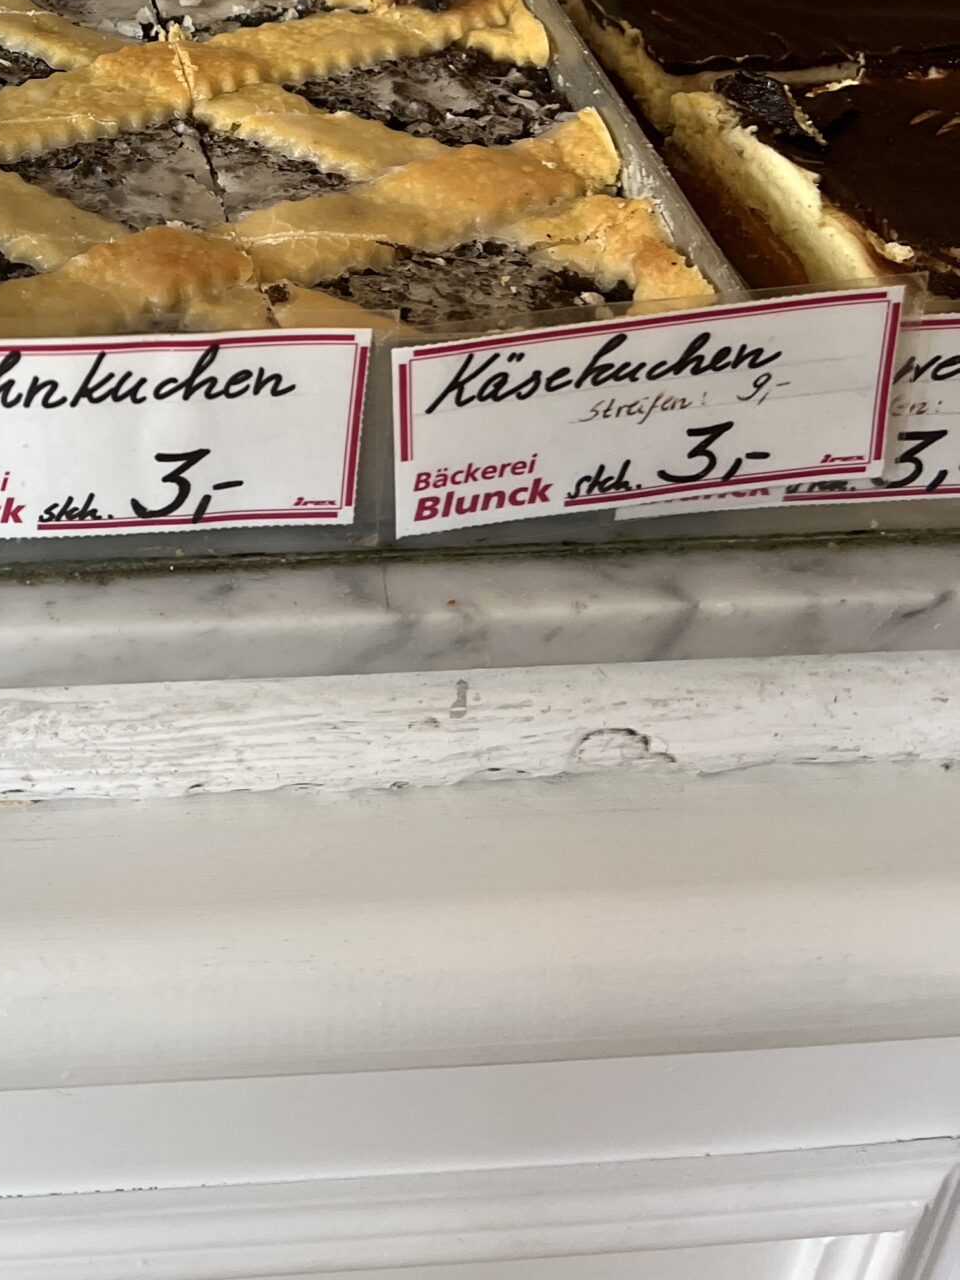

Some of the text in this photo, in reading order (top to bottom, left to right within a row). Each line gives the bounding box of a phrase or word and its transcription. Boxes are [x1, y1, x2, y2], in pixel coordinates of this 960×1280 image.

[425, 332, 782, 414] Käsekuchen
[736, 372, 791, 406] 9,-
[131, 448, 245, 524] 3,-
[413, 453, 538, 493] Bäckerei
[413, 478, 554, 522] Blunck
